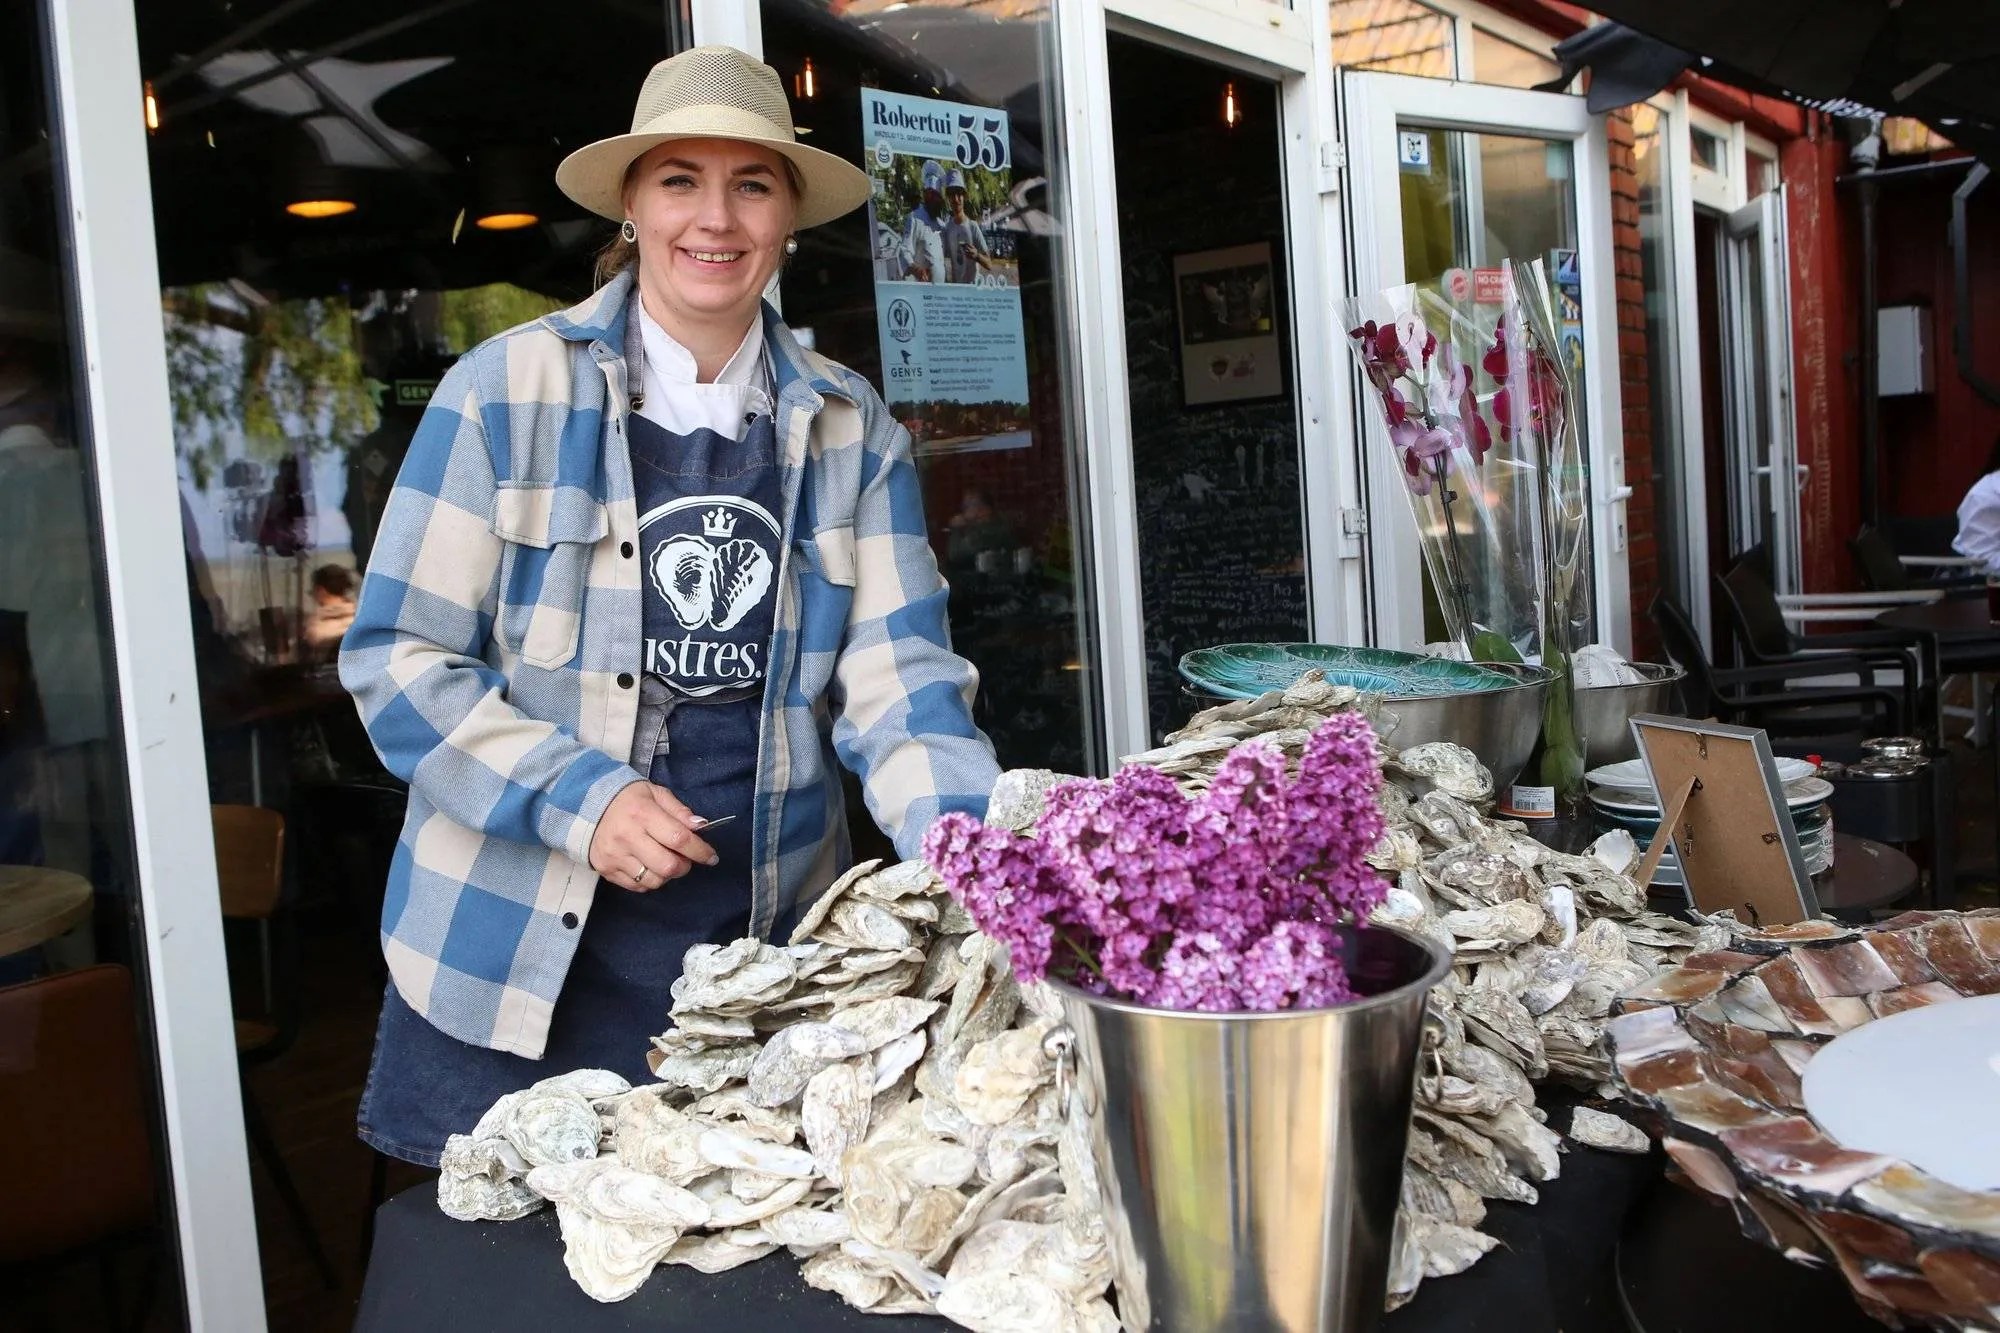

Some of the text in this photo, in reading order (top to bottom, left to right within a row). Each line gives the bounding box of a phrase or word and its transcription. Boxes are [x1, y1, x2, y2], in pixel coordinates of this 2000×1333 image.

[872, 101, 1006, 169] Robertui 55
[890, 367, 923, 378] GENYS
